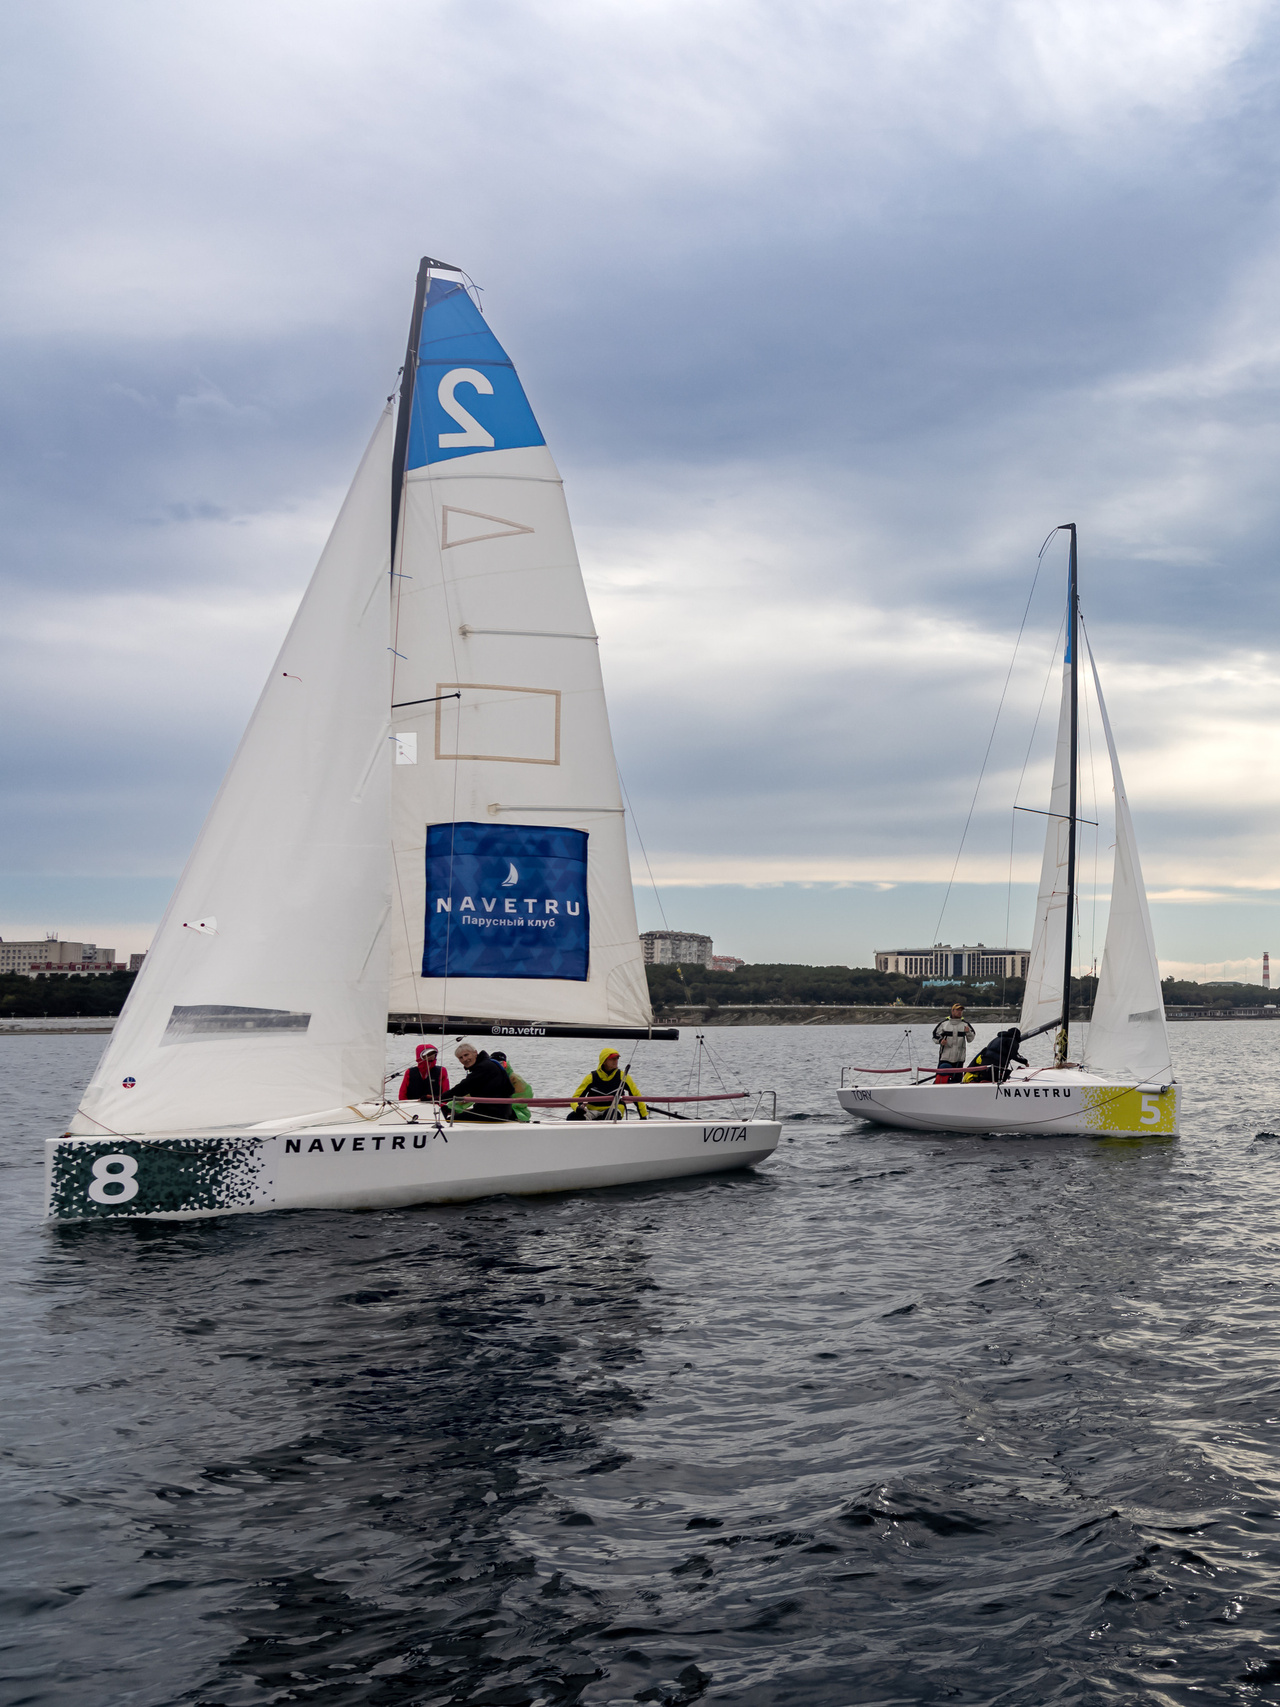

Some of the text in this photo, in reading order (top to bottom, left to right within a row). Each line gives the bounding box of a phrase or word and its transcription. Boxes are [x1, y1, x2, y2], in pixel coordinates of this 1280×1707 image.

[436, 896, 581, 916] NAVETRU
[462, 915, 556, 929] Парусный клуб
[851, 1090, 872, 1101] TORY
[1003, 1088, 1071, 1098] NAVETRU
[1139, 1094, 1161, 1125] 5
[285, 1134, 427, 1153] NAVETRU
[703, 1126, 747, 1143] VOITA
[88, 1153, 139, 1205] 8
